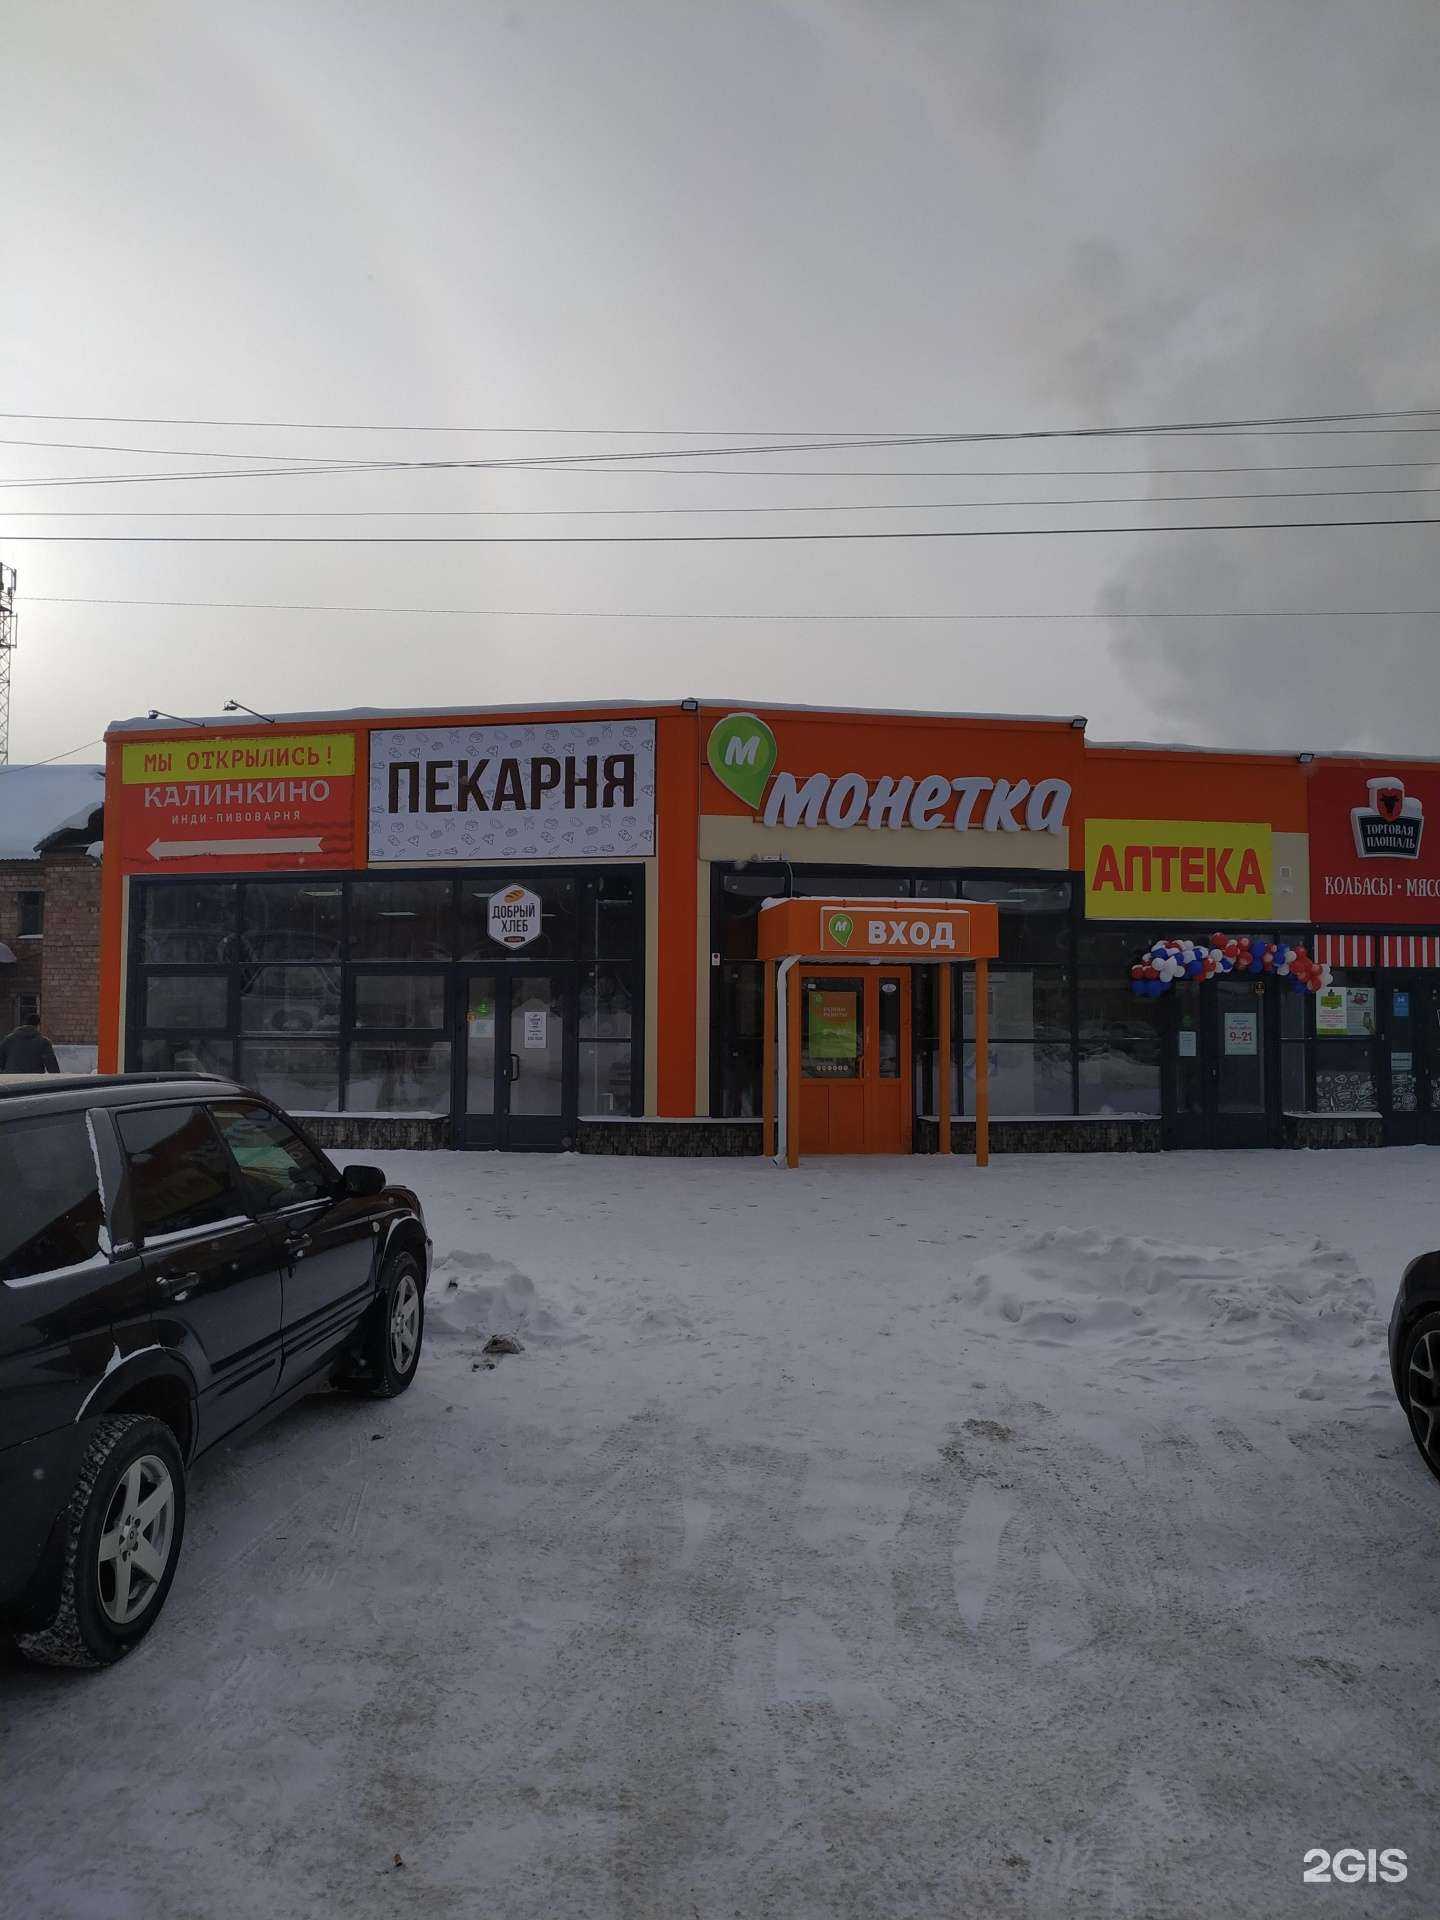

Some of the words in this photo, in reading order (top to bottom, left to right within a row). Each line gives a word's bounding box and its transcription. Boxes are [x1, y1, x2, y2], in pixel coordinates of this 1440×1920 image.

[144, 753, 172, 772] МЫ
[186, 746, 332, 770] ОТКРЫЛИСЬ!
[144, 779, 330, 808] КАЛИНКИНО
[388, 754, 635, 813] ПЕКАРНЯ
[171, 810, 301, 825] ИНДИ-ПИВОВАРНЯ
[1365, 823, 1414, 837] ТОРГОВАЯ
[1366, 836, 1416, 849] ПЛОЩАДЬ
[1092, 845, 1266, 894] АПТЕКА
[1325, 876, 1393, 897] КОЛБАСЫ
[492, 903, 535, 919] ДОБРЫЙ
[501, 920, 528, 933] ХЛЕБ
[868, 920, 955, 949] ВХОД
